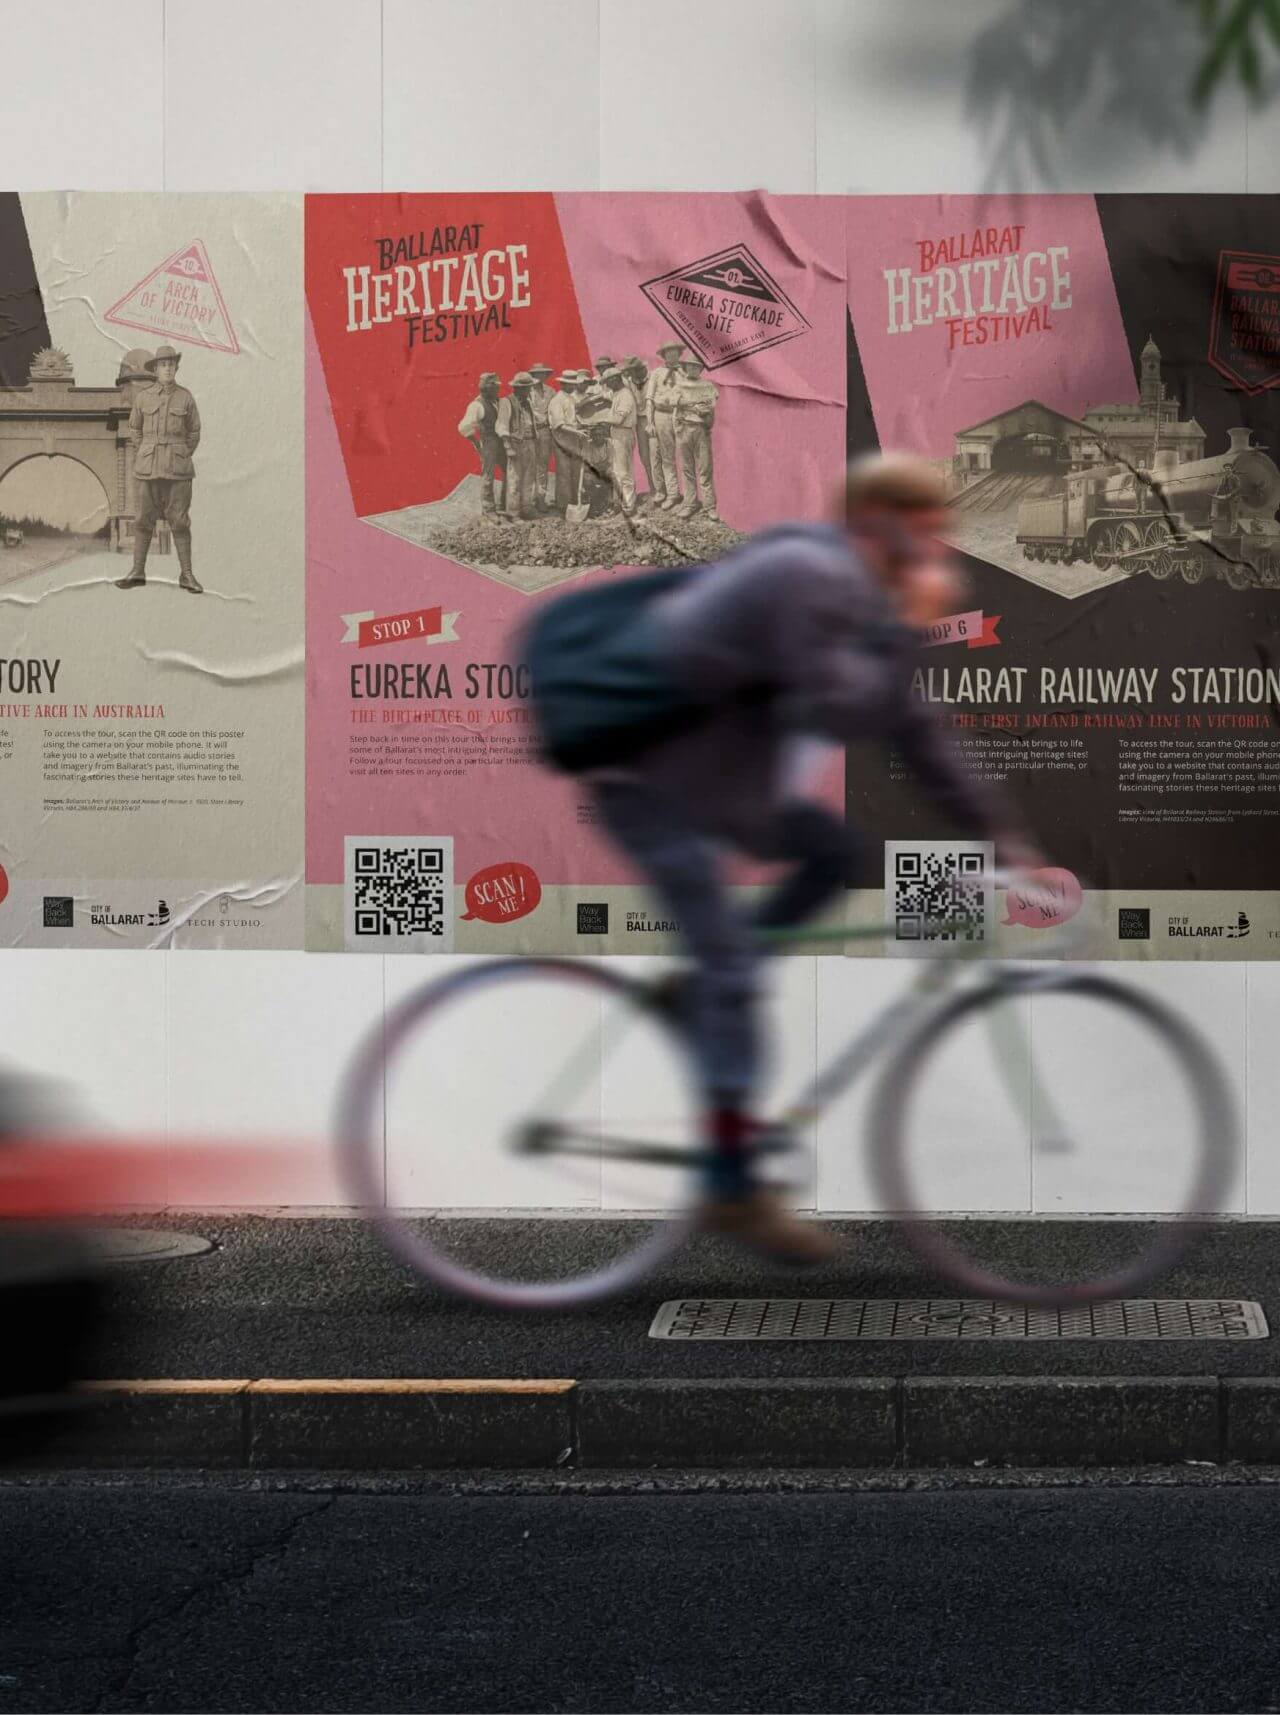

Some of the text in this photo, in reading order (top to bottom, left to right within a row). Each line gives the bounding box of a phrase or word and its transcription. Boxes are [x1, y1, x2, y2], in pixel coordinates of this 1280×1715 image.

[375, 224, 484, 270] BALLARAT
[916, 225, 1025, 273] BALLARAT
[165, 280, 199, 301] ARCH
[344, 245, 531, 332] HERITAGE
[884, 246, 1072, 334] HERITAGE
[141, 292, 158, 308] OF
[163, 297, 216, 324] VICTORY
[667, 285, 784, 327] EUREKA STOCKADE
[1231, 296, 1280, 315] BALLAR
[404, 304, 511, 347] FESTIVAL
[706, 313, 735, 334] SITE
[945, 304, 1052, 350] FESTIVAL
[372, 617, 425, 641] STOP 1
[958, 620, 967, 635] 6
[350, 663, 532, 699] EUREKA STOC
[911, 667, 1280, 703] ALLARAT RAILWAY STATION
[34, 704, 68, 718] ARCH
[73, 704, 87, 718] IN
[94, 704, 165, 718] AUSTRALIA
[350, 710, 376, 723] THE
[382, 710, 462, 723] BIRTHPLACE
[468, 710, 481, 723] OF
[952, 714, 977, 728] THE
[983, 714, 1019, 728] FIRST
[1026, 714, 1079, 728] INLAND
[1084, 714, 1142, 728] RAILWAY
[1149, 714, 1181, 728] LINE
[1186, 714, 1201, 728] IN
[1208, 714, 1271, 728] VICTORIA
[43, 729, 245, 740] To access the tour, scan the QR code on this poster
[962, 739, 1083, 749] on this tour that brings to life
[91, 905, 111, 913] CITY OF
[91, 914, 145, 925] BALLARAT
[188, 919, 215, 927] TECH
[627, 921, 680, 932] BALLARA
[1168, 917, 1189, 925] CITY OF
[1168, 926, 1224, 937] BALLARAT
